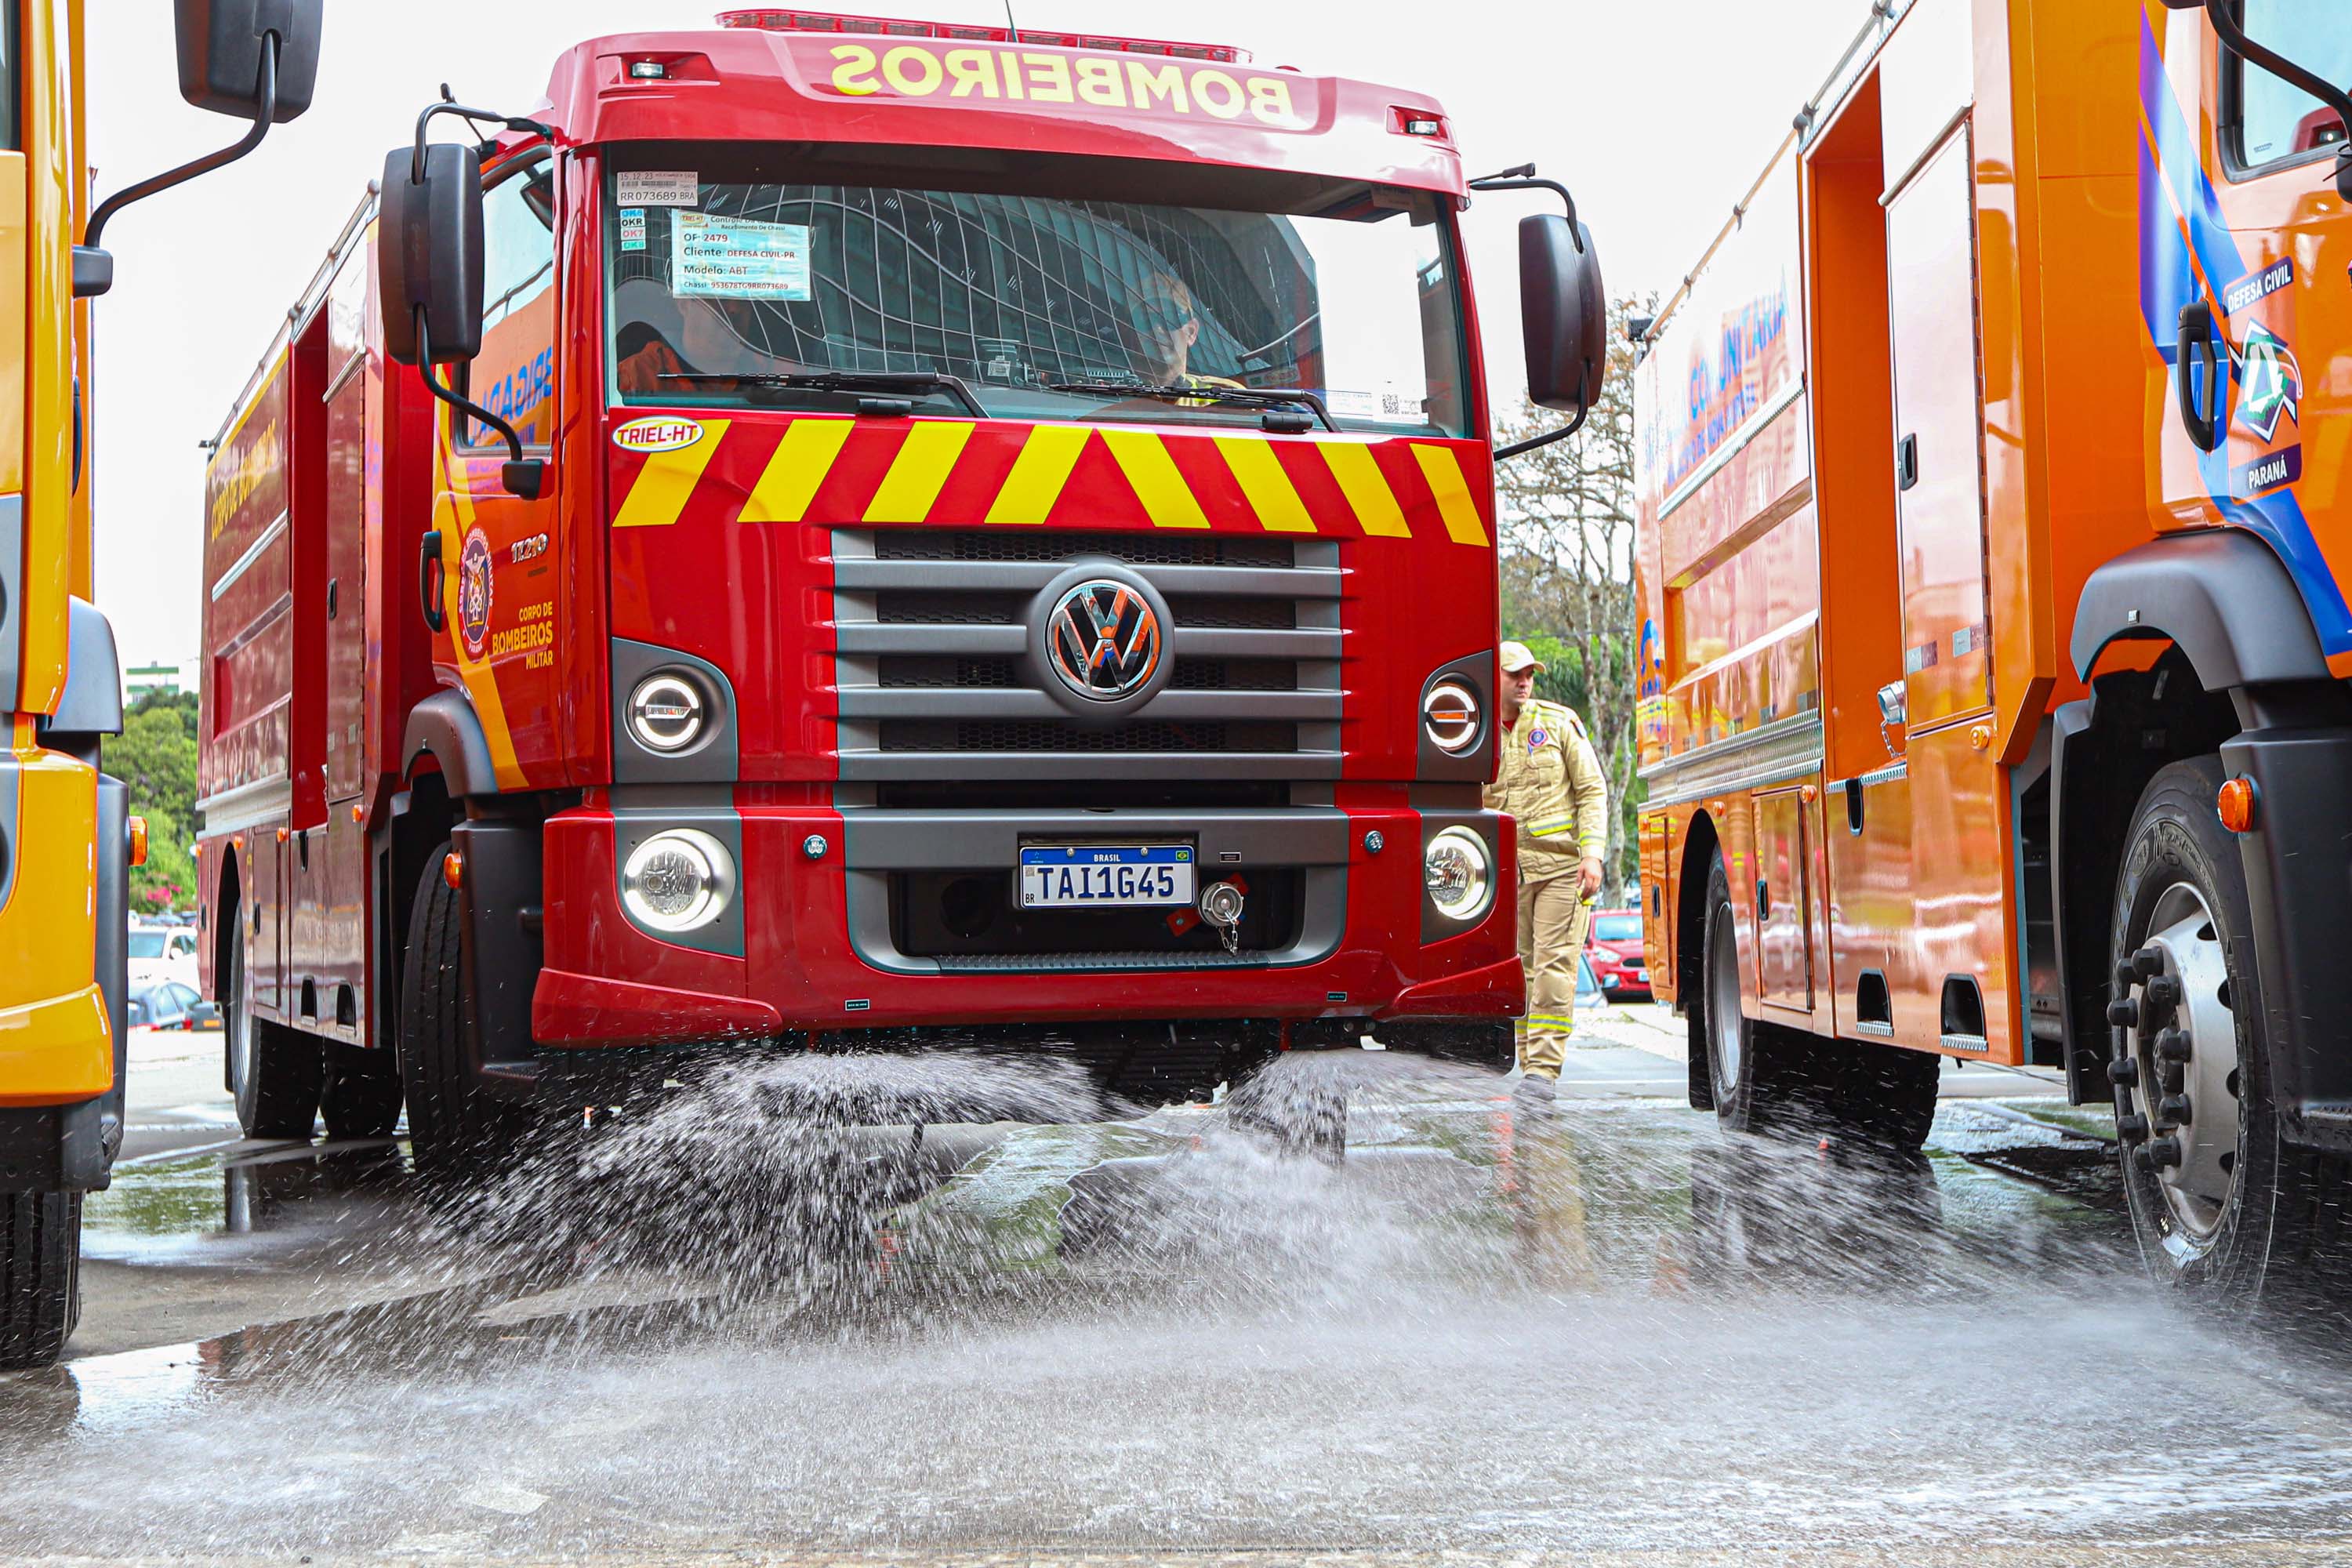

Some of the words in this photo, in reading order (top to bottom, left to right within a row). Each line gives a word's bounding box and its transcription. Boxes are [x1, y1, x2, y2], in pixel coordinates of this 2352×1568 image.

[620, 191, 677, 201] RR073689
[680, 191, 695, 200] BRA
[622, 218, 643, 227] OKR
[703, 234, 728, 242] 2479
[2228, 284, 2263, 313] DEFESA
[2265, 264, 2292, 292] CIVIL
[618, 425, 698, 445] TRIEL-HT
[2249, 455, 2287, 490] PARANÁ
[519, 604, 542, 622] CORPO
[543, 601, 553, 616] DE
[492, 620, 553, 655] BOMBEIROS
[526, 650, 554, 670] MILITAR
[1094, 854, 1121, 862] BRASIL
[1037, 866, 1174, 899] TAI1G45
[1025, 893, 1035, 904] BR
